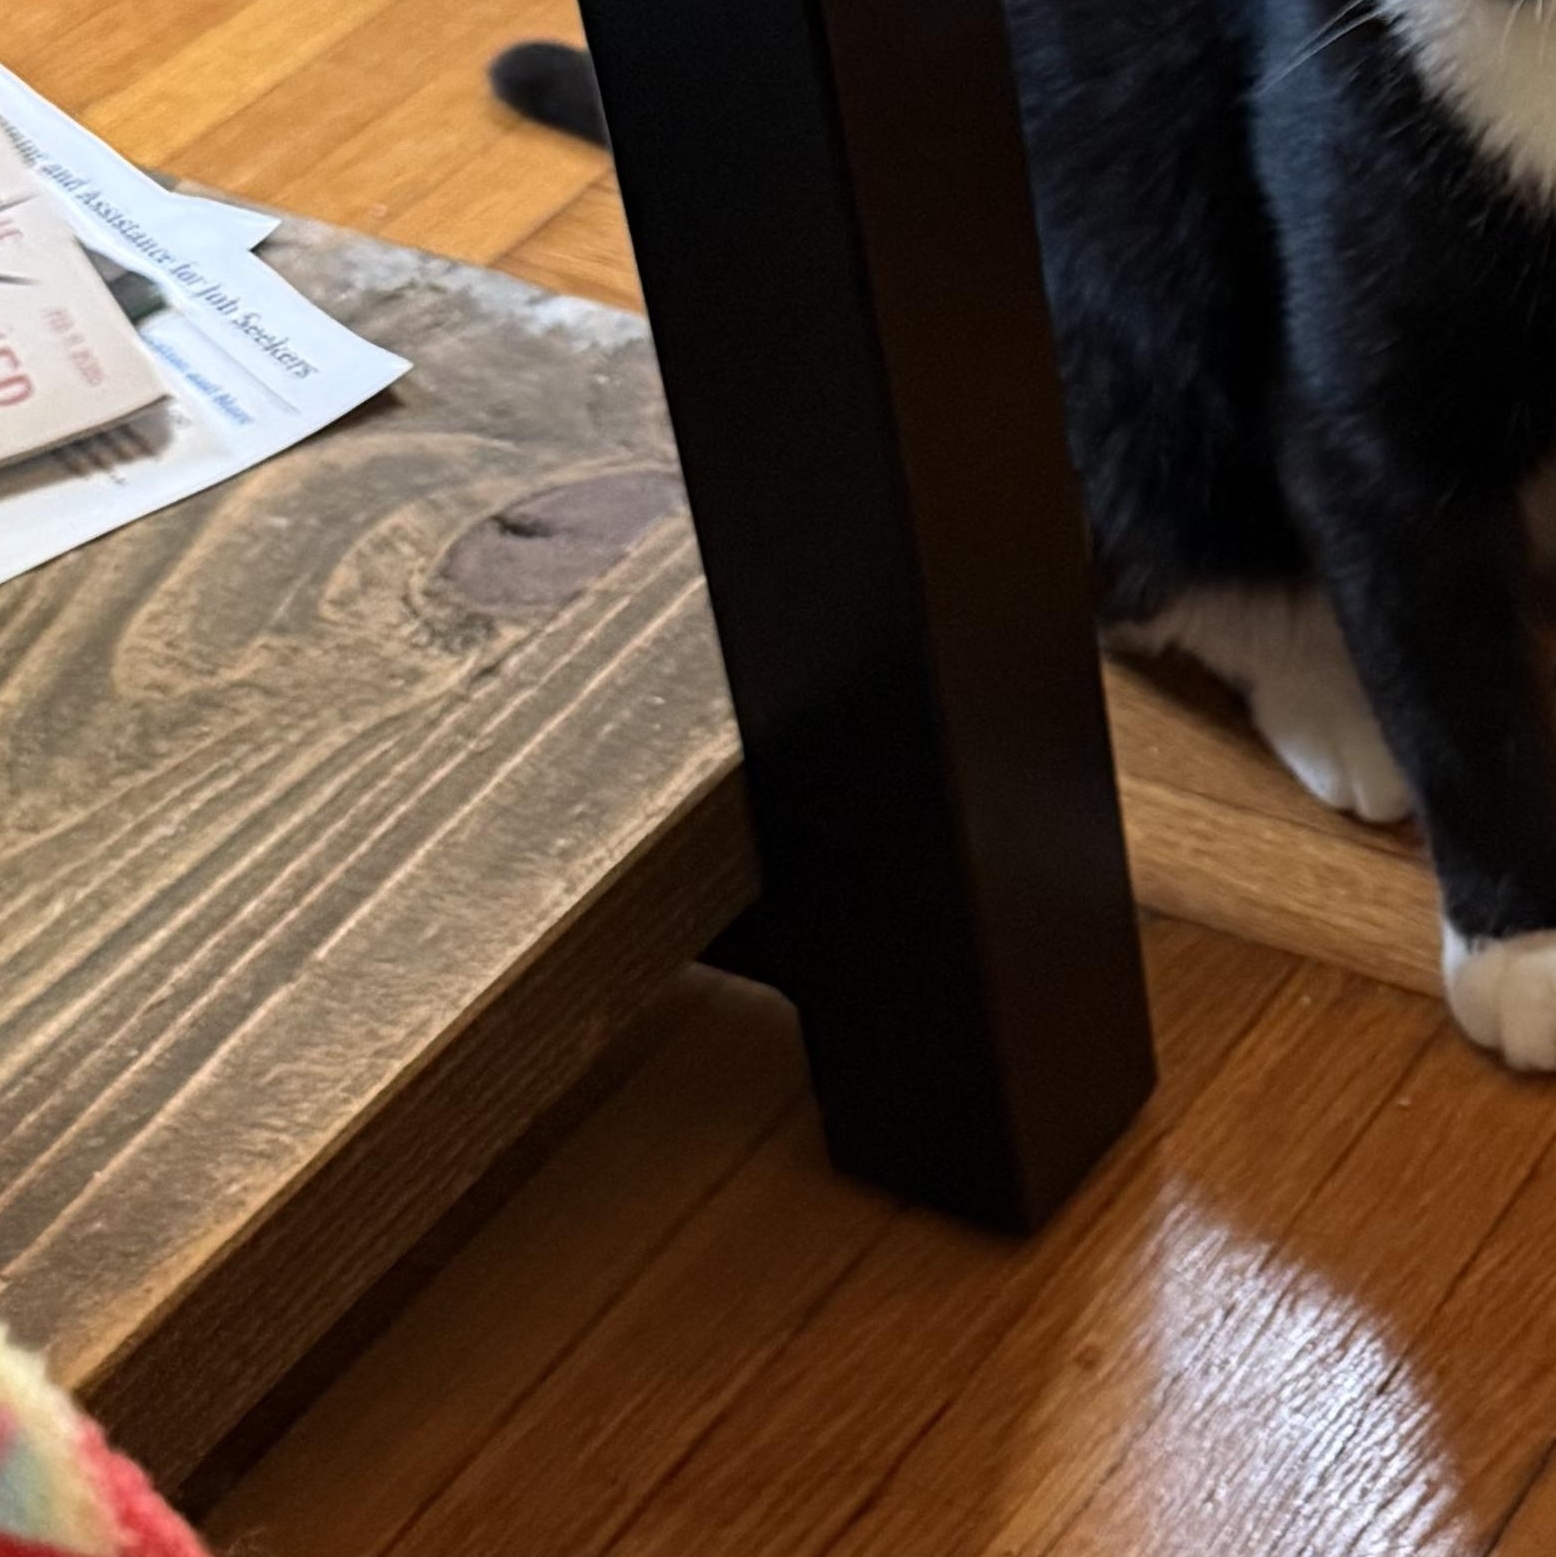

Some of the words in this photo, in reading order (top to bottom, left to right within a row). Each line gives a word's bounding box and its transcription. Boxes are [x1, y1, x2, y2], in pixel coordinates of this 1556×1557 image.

[40, 164, 91, 192] and
[75, 189, 173, 265] Assistance
[169, 260, 206, 286] for
[191, 282, 241, 315] Job
[230, 311, 319, 380] Seekers
